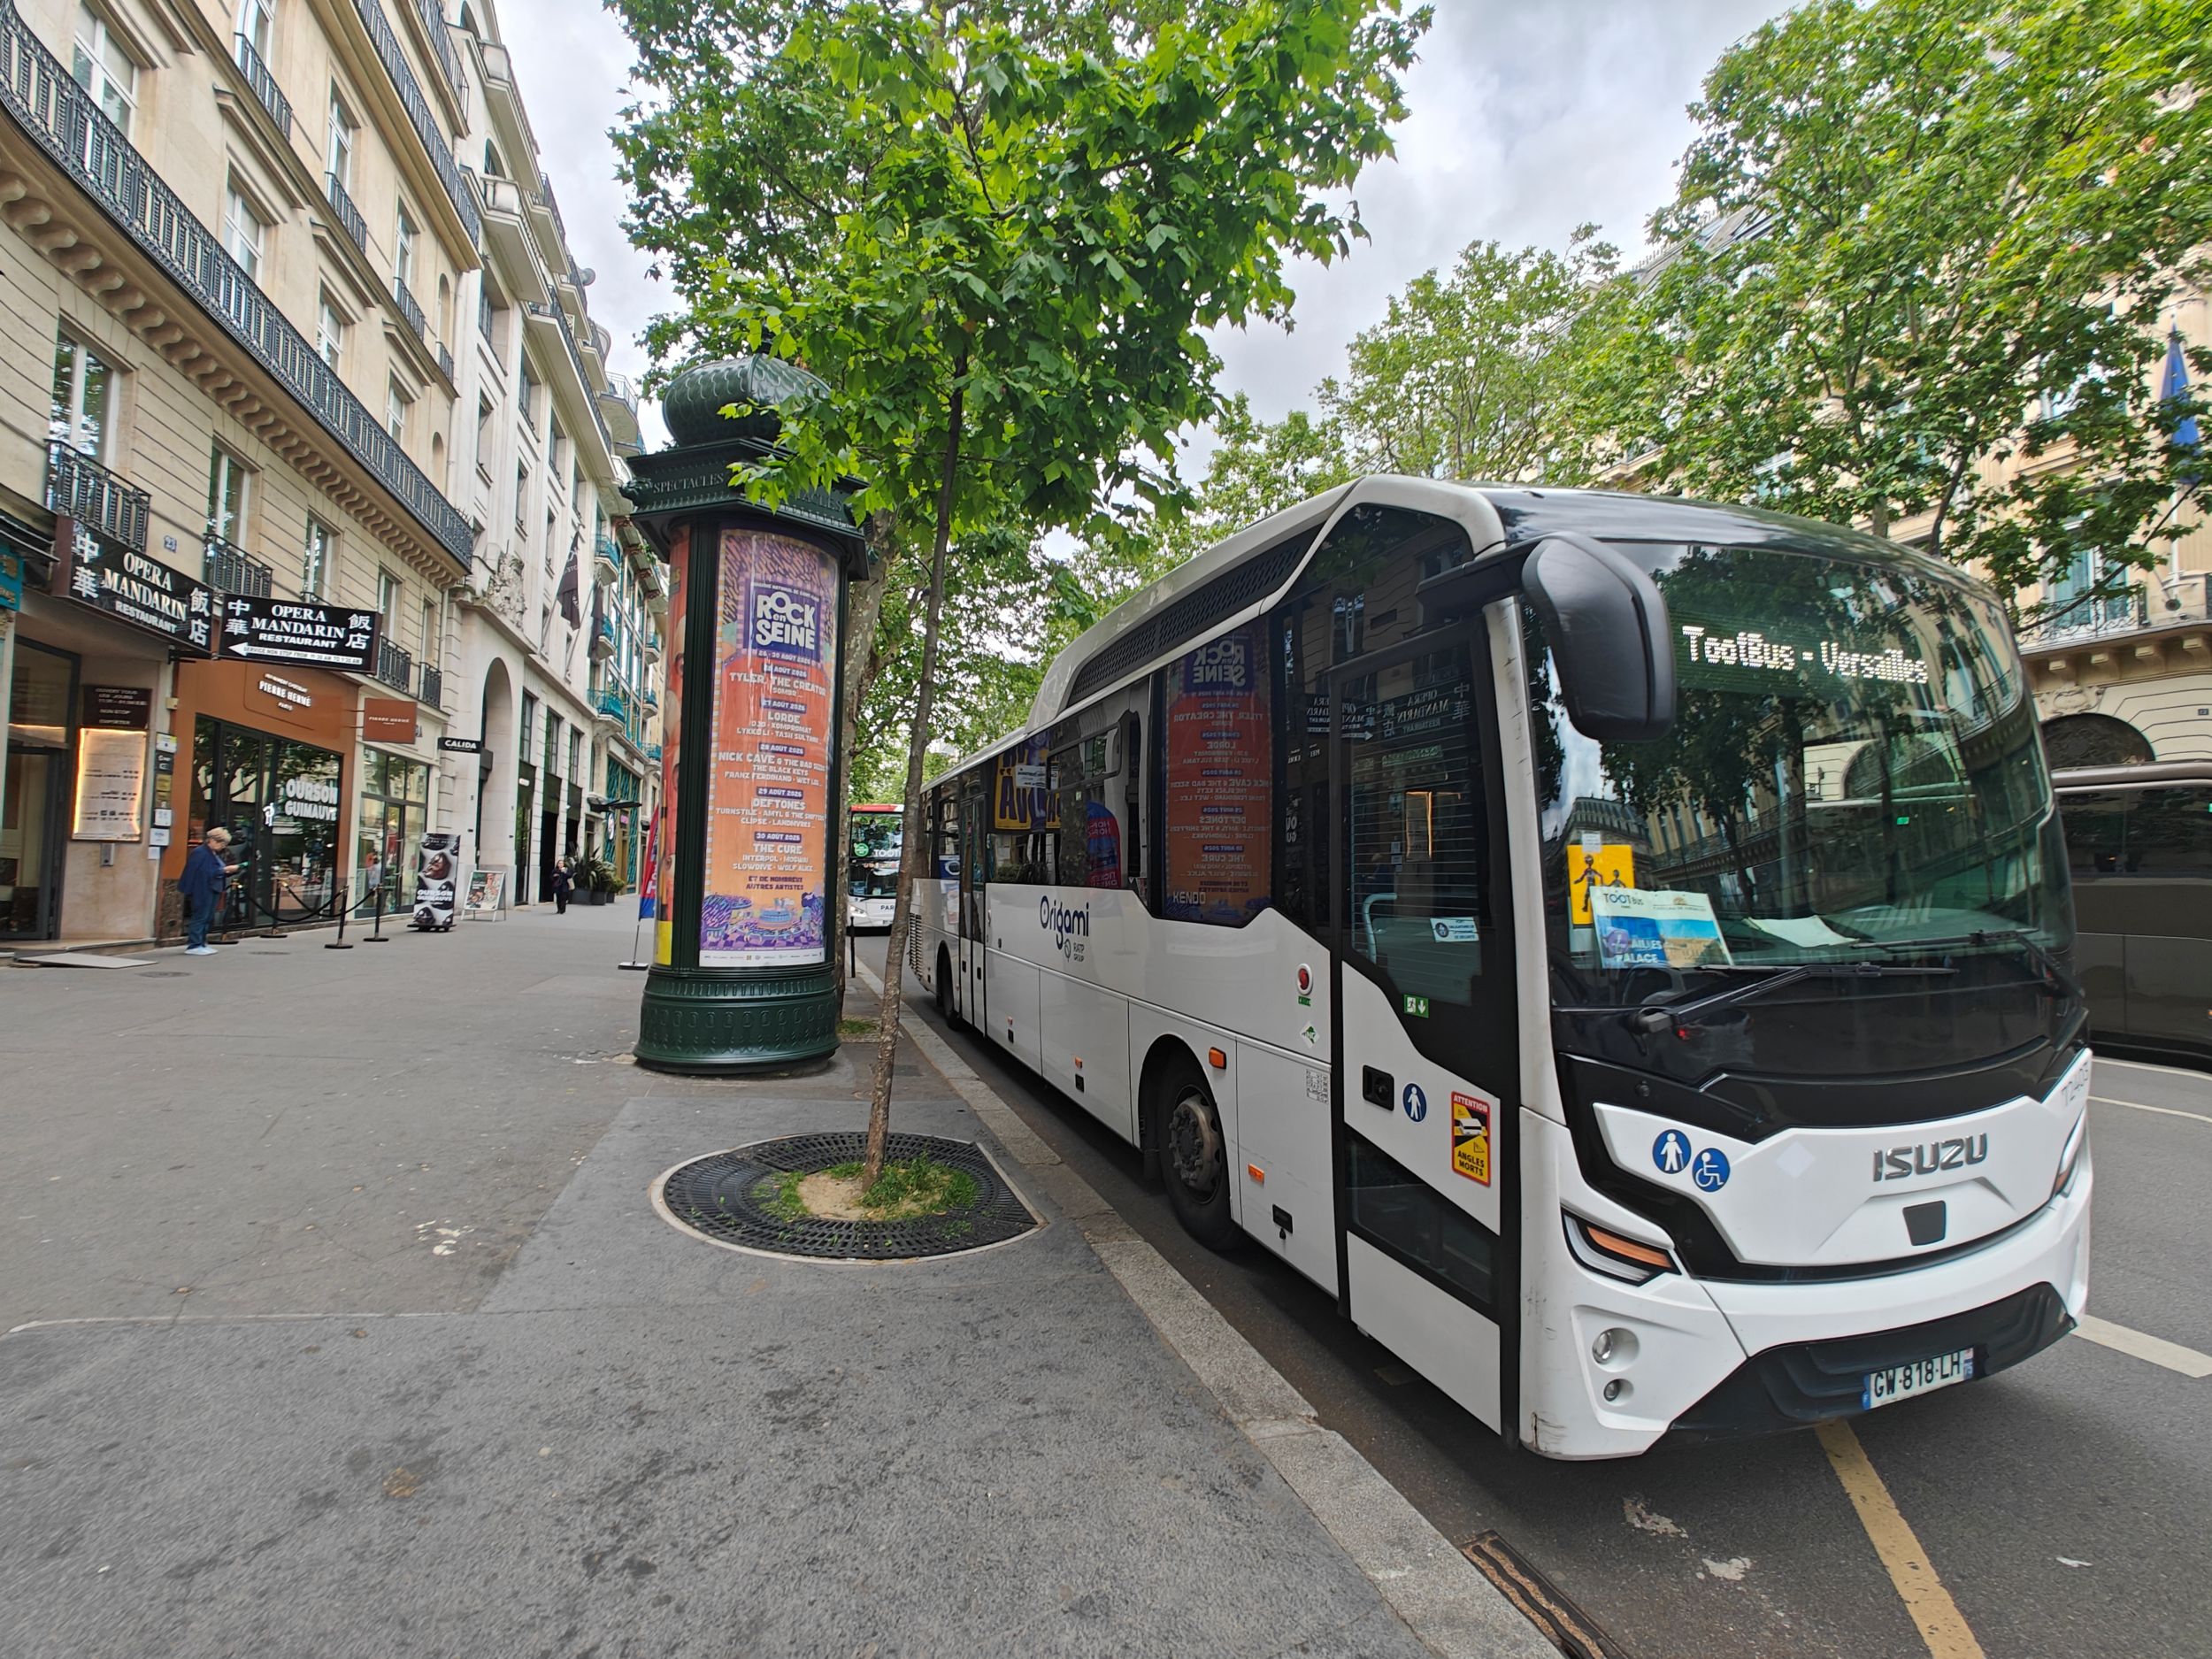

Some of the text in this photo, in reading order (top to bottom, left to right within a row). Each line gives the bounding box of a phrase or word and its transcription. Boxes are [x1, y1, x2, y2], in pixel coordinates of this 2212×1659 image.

[653, 472, 725, 494] SPECTACLES
[72, 533, 99, 598] 中華
[123, 552, 173, 591] OPERA
[102, 568, 187, 621] MANDARIN
[115, 601, 177, 634] RESTAURANT
[188, 588, 210, 647] 飯店
[225, 599, 250, 635] 中華
[272, 604, 326, 622] OPERA
[757, 591, 815, 630] ROCK
[772, 613, 787, 622] en
[250, 617, 346, 639] MANDARIN
[345, 613, 373, 649] 飯店
[756, 619, 815, 650] SEINE
[258, 633, 337, 649] RESTAURANT
[259, 680, 311, 707] PIERRE HERMÉ
[772, 676, 791, 687] THE
[793, 680, 826, 696] CREATOR
[767, 711, 801, 724] LORDE
[444, 740, 477, 749] CALIDA
[718, 752, 743, 762] NICK
[747, 753, 775, 764] CAVE
[784, 758, 798, 767] THE
[752, 772, 793, 781] FERDINAND
[286, 779, 338, 804] OURSON
[285, 800, 337, 821] GUIMAUVE
[715, 807, 758, 816] TURNSTILE
[753, 797, 806, 810] DEFTONES
[753, 843, 803, 855] THE CURE
[1173, 891, 1206, 904] KENDO
[1603, 893, 1632, 903] TOOT
[1040, 895, 1089, 950] Origami
[1454, 1094, 1487, 1113] ATTENTION
[1457, 1149, 1485, 1168] ANGLES
[1458, 1159, 1484, 1177] MORTS
[1873, 1133, 1988, 1182] ISUZU
[1874, 1350, 1961, 1399] GW-818-LH
